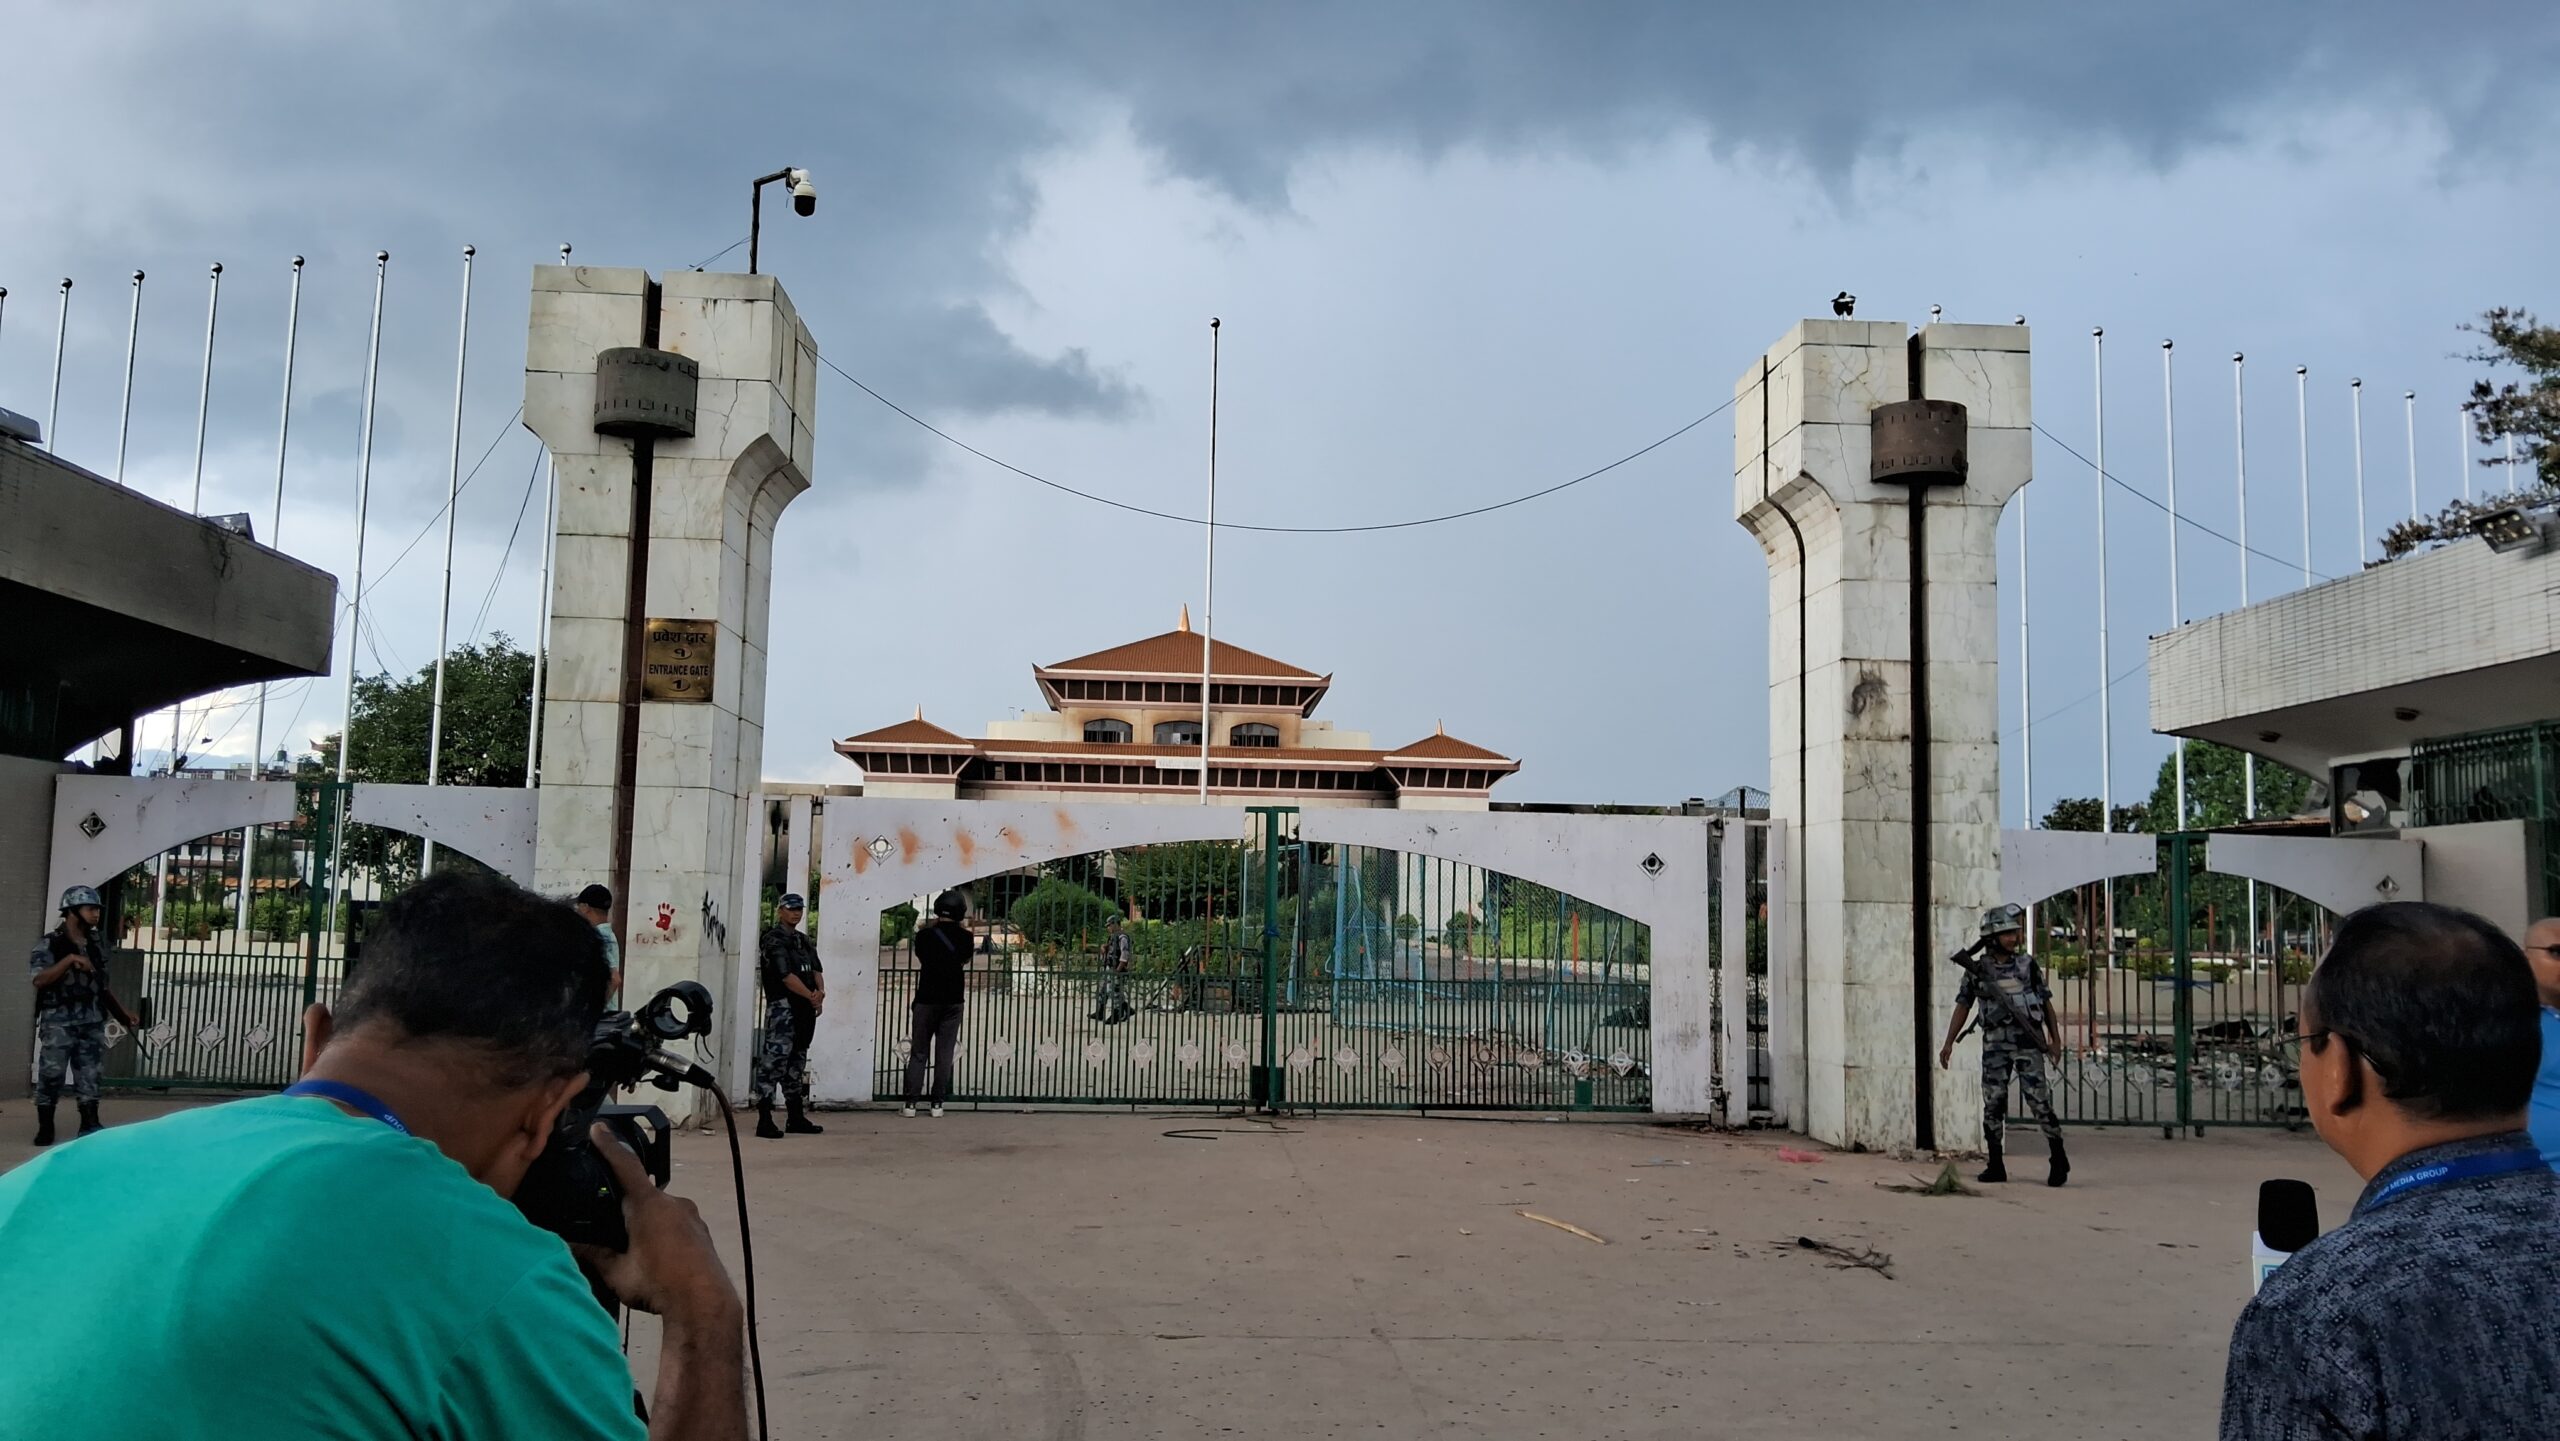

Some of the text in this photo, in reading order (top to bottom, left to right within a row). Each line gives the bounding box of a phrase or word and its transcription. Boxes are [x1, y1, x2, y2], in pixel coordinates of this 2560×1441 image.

[653, 628, 682, 643] प्रवेश
[648, 664, 709, 676] ENTRANCE GATE
[672, 679, 682, 689] 1
[2390, 1166, 2448, 1190] MEDIA GROUP
